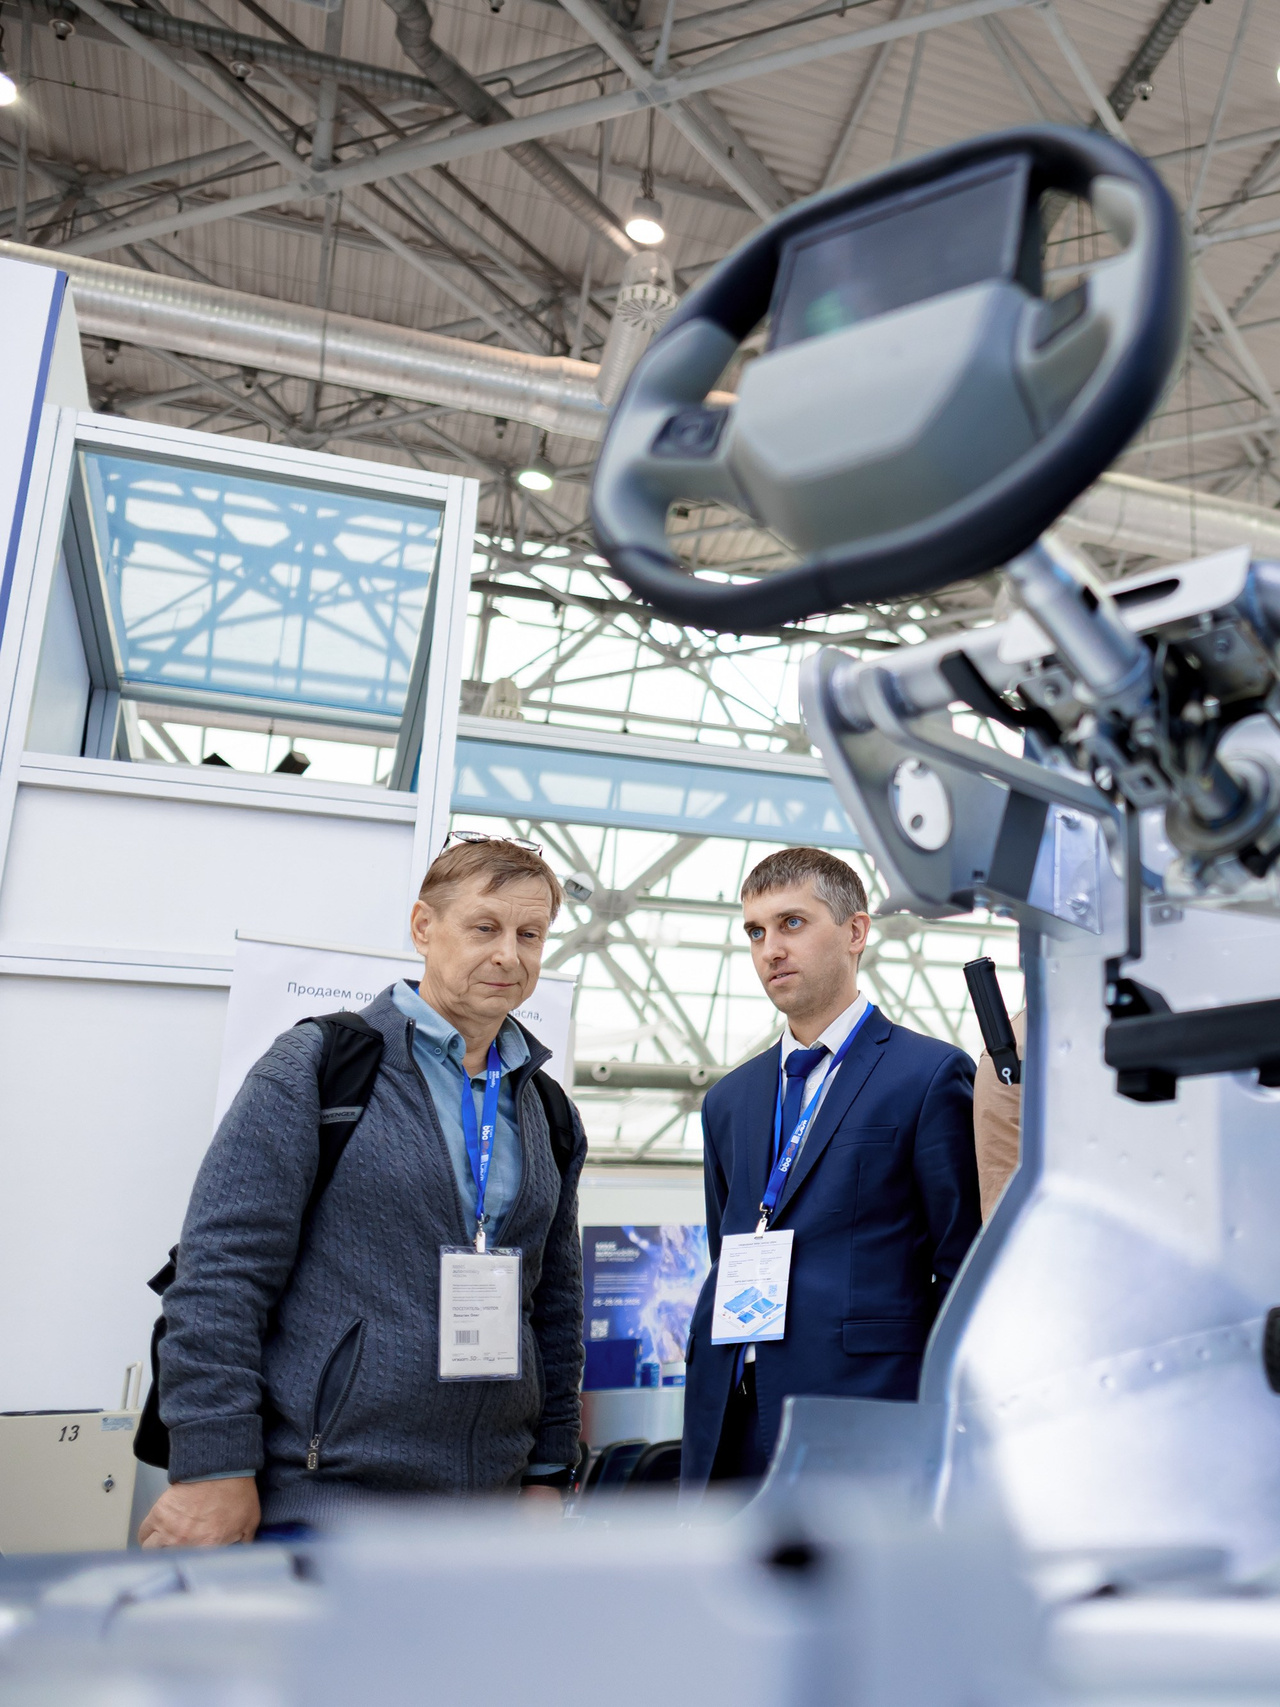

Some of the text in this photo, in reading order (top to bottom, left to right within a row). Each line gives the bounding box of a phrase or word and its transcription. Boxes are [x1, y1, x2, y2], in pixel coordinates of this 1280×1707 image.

[287, 982, 352, 999] Продаем
[322, 1111, 356, 1119] WENGER
[58, 1424, 81, 1442] 13
